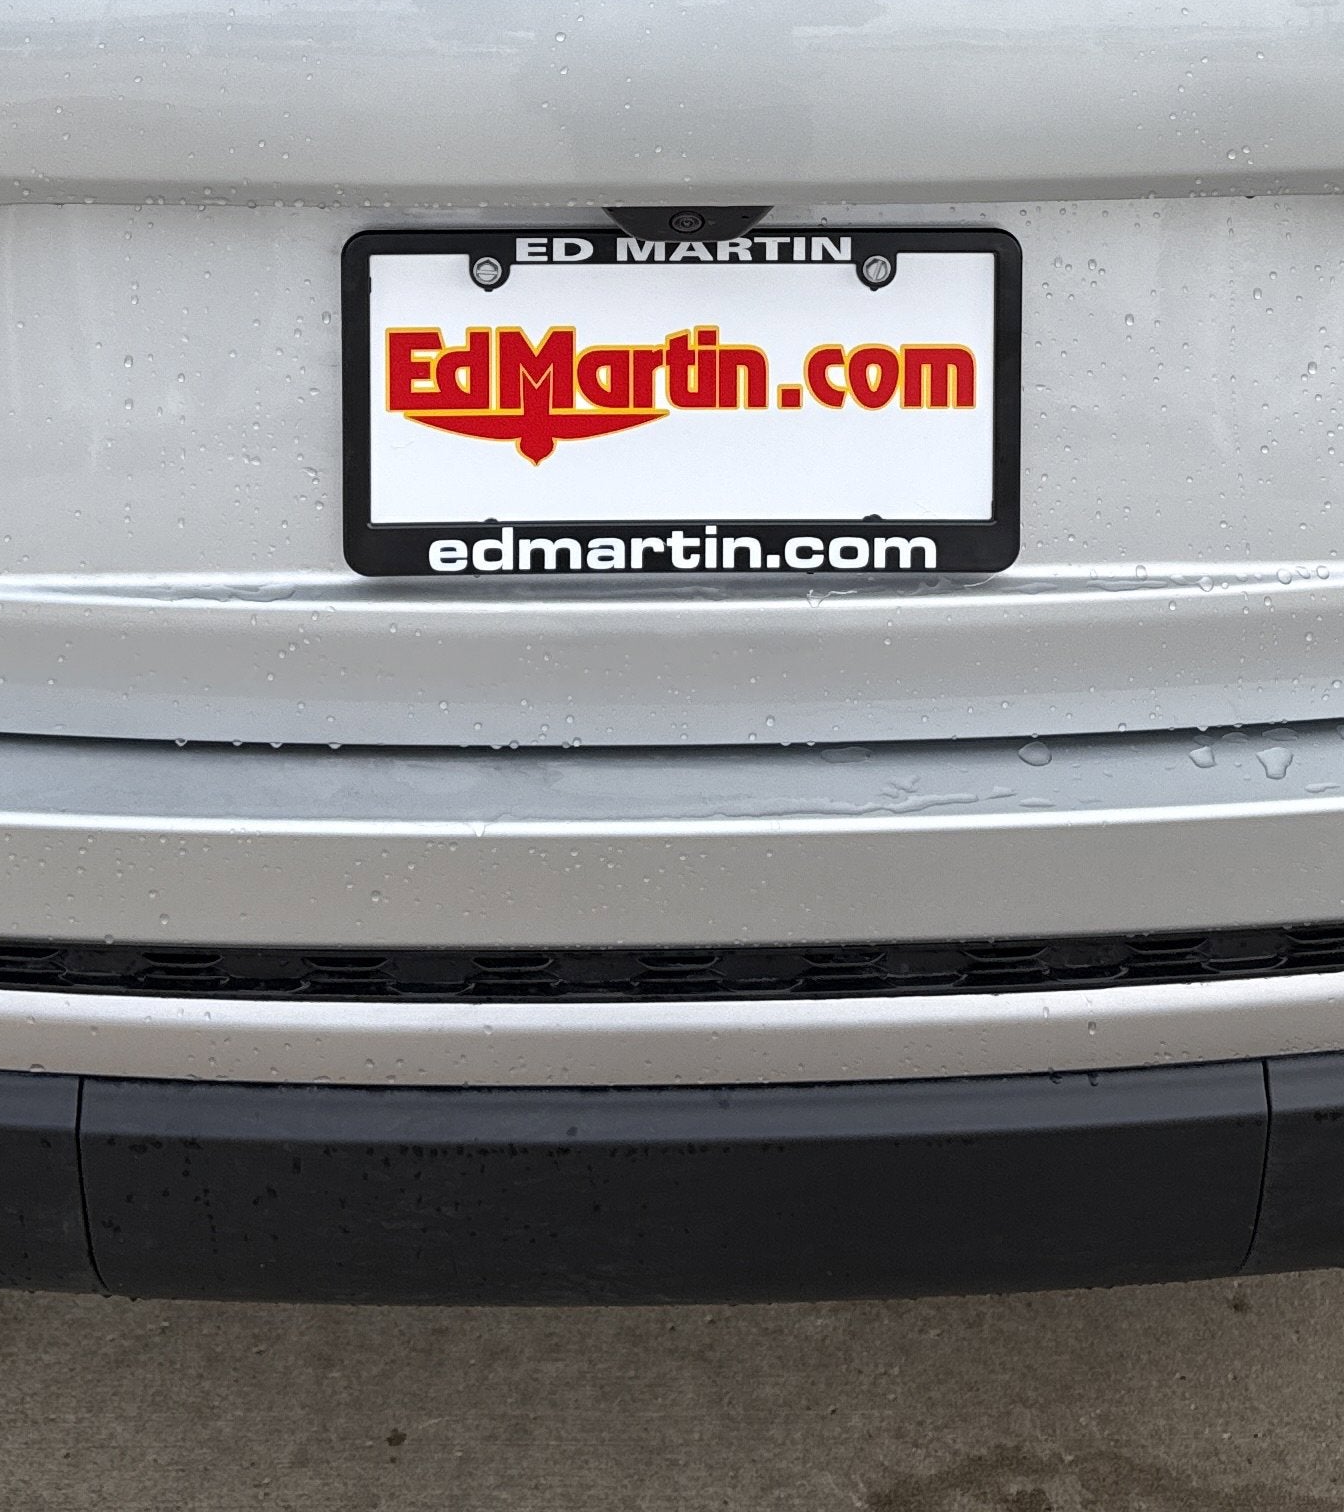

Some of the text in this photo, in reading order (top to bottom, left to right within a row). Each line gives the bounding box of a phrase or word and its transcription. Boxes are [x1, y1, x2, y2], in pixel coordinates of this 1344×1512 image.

[515, 237, 853, 262] ED MARTIN
[385, 326, 977, 410] EdMartin.com
[429, 525, 937, 570] edmartin.com
